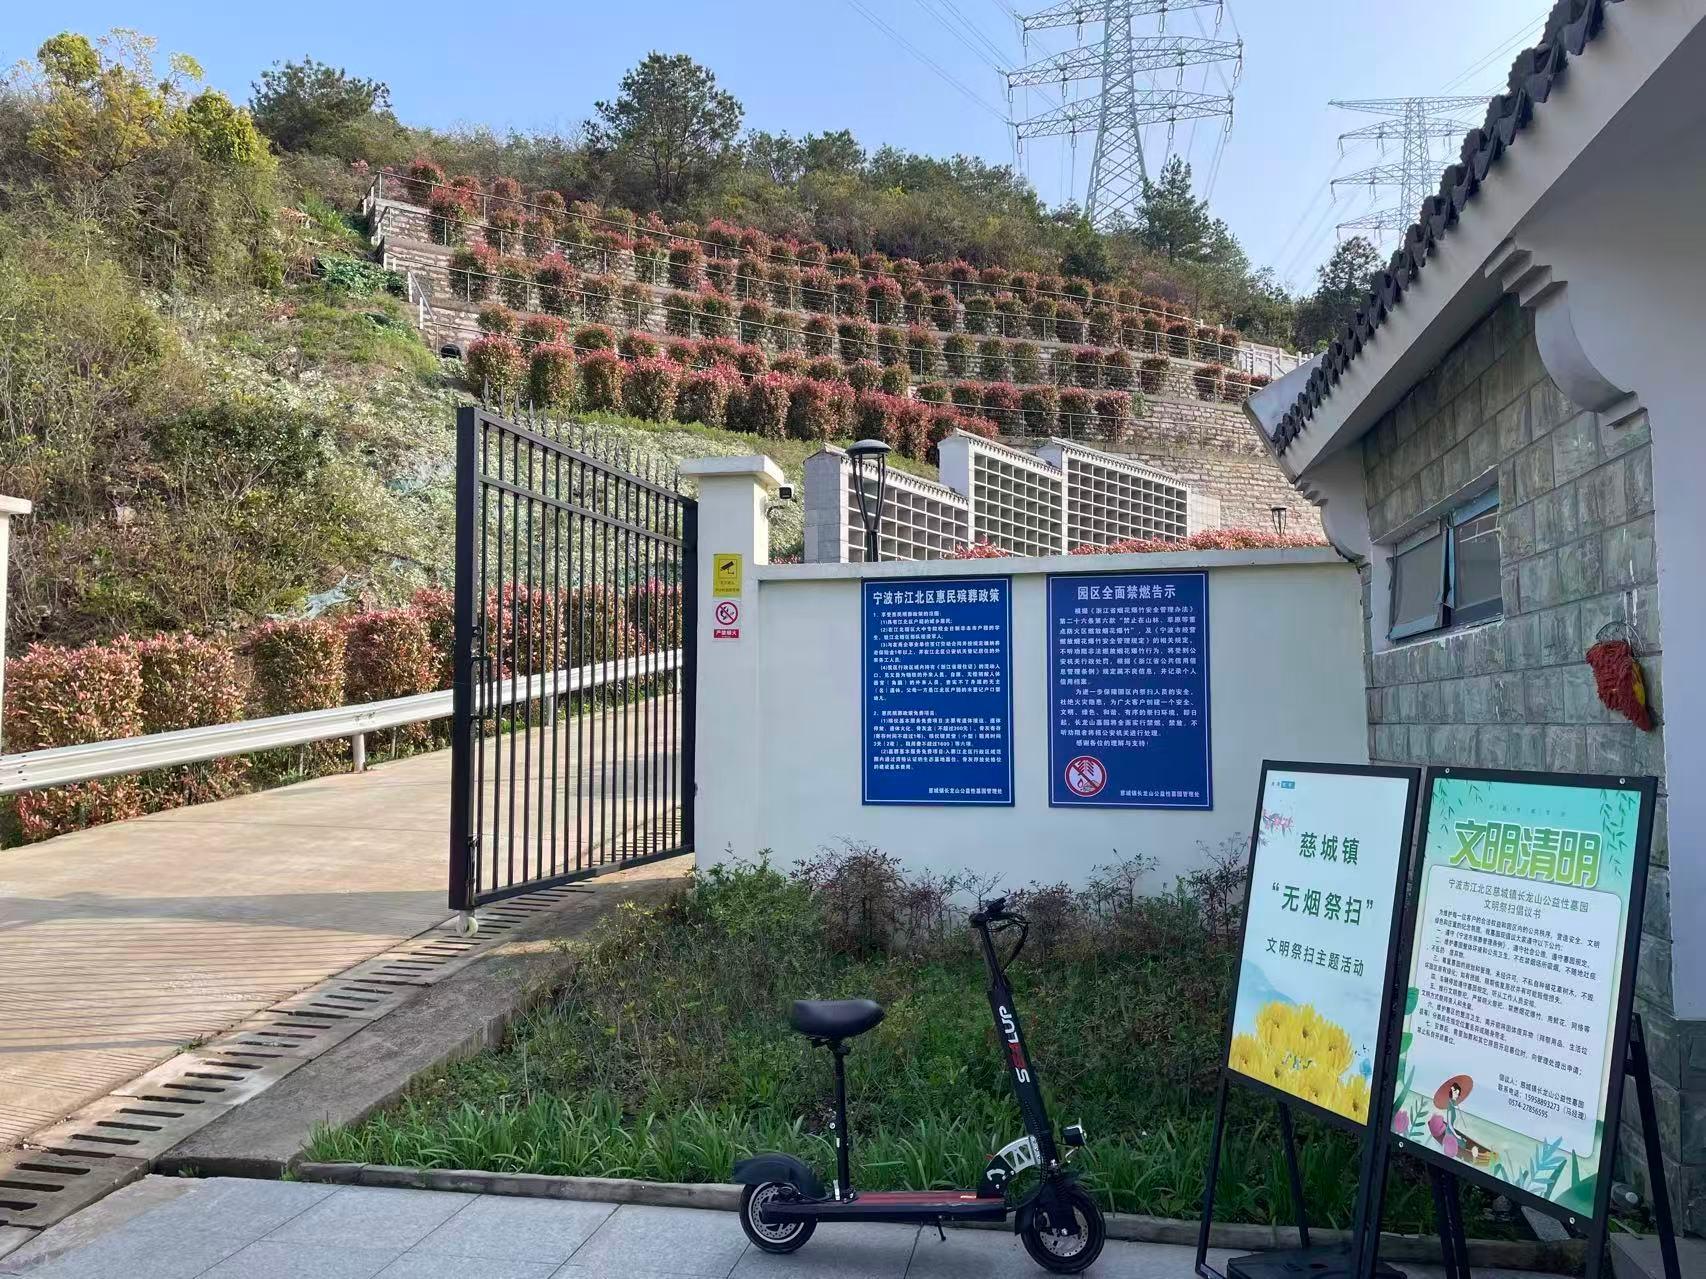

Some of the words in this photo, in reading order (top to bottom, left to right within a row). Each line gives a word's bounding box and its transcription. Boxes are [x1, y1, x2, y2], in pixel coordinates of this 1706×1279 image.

[872, 587, 999, 605] 宁波市江北区惠民殡葬政策
[1077, 584, 1175, 600] 园区全面禁燃告示
[1298, 832, 1360, 866] 慈城镇
[1448, 816, 1603, 889] 文明清明
[1272, 881, 1374, 926] “无烟祭扫”
[1447, 877, 1589, 913] 宁波市江北区慈城镇长龙山公益性墓园
[1482, 898, 1542, 920] 文明祭扫倡议书
[1265, 936, 1365, 977] 文明祭扫主题活动
